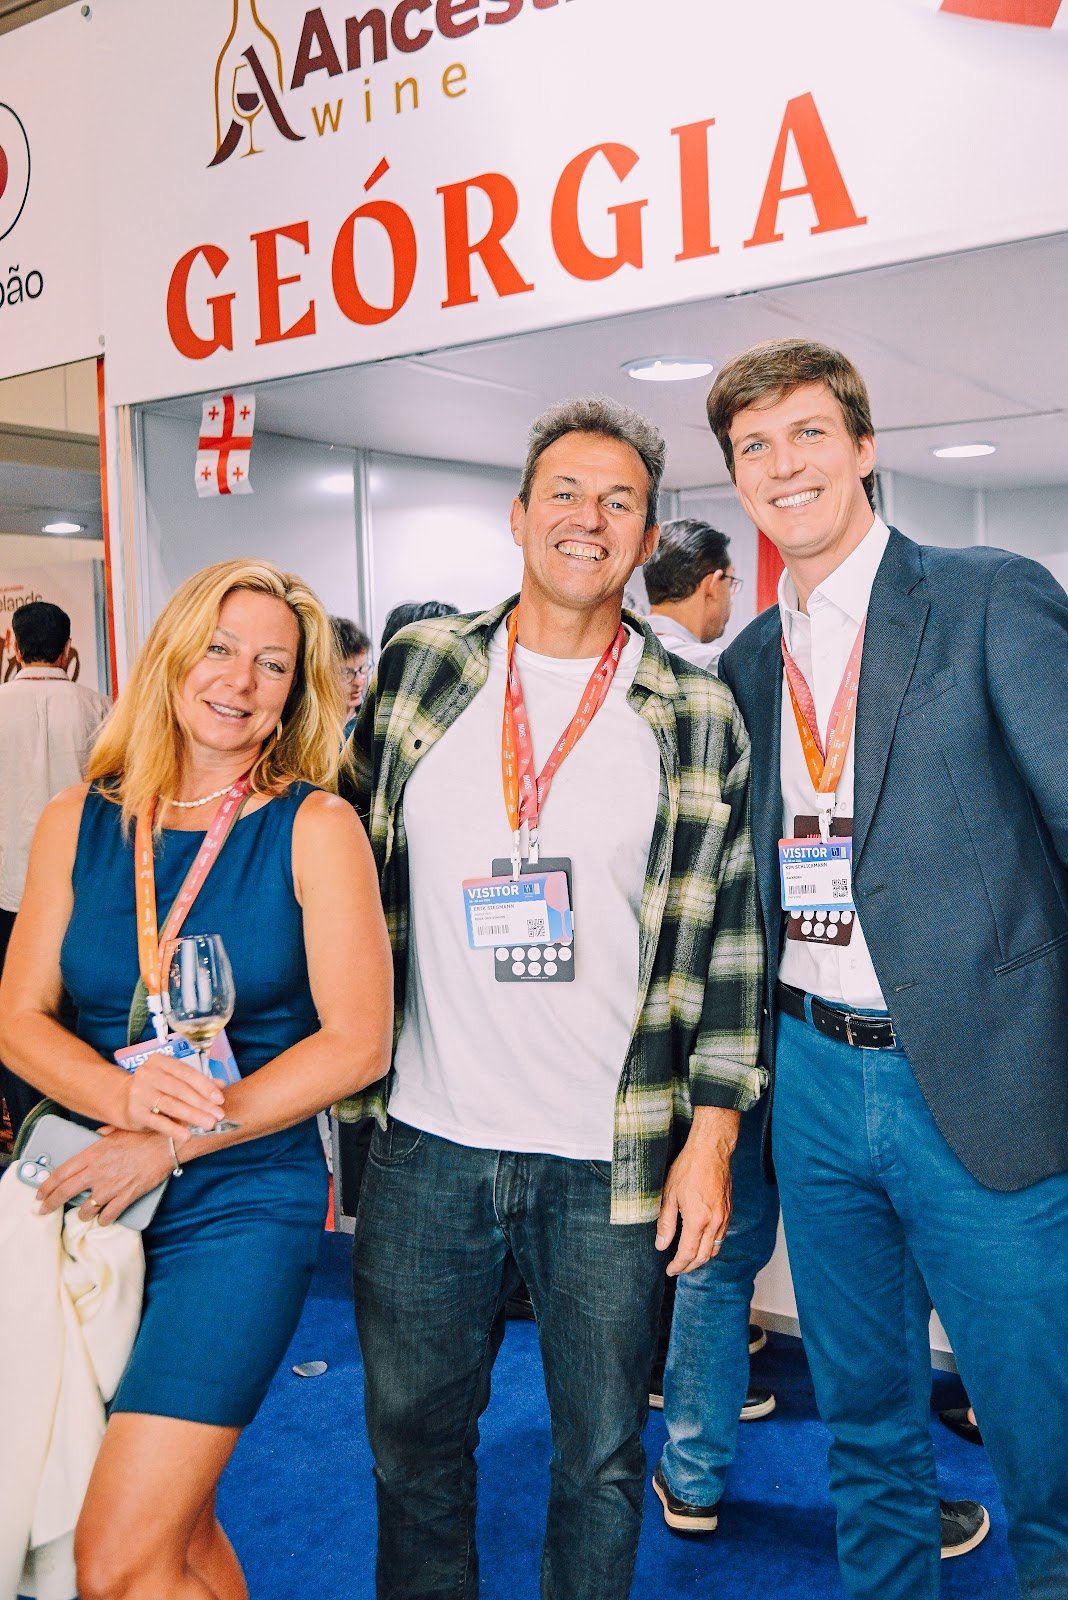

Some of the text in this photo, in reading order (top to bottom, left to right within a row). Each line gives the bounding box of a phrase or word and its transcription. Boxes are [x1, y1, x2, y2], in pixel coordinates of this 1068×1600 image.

[290, 0, 578, 90] Ance
[311, 61, 467, 137] wine
[167, 91, 868, 360] GEÓRGIA
[782, 847, 828, 859] VISITOR
[467, 885, 519, 899] VISITOR
[121, 1045, 175, 1070] VISIR
